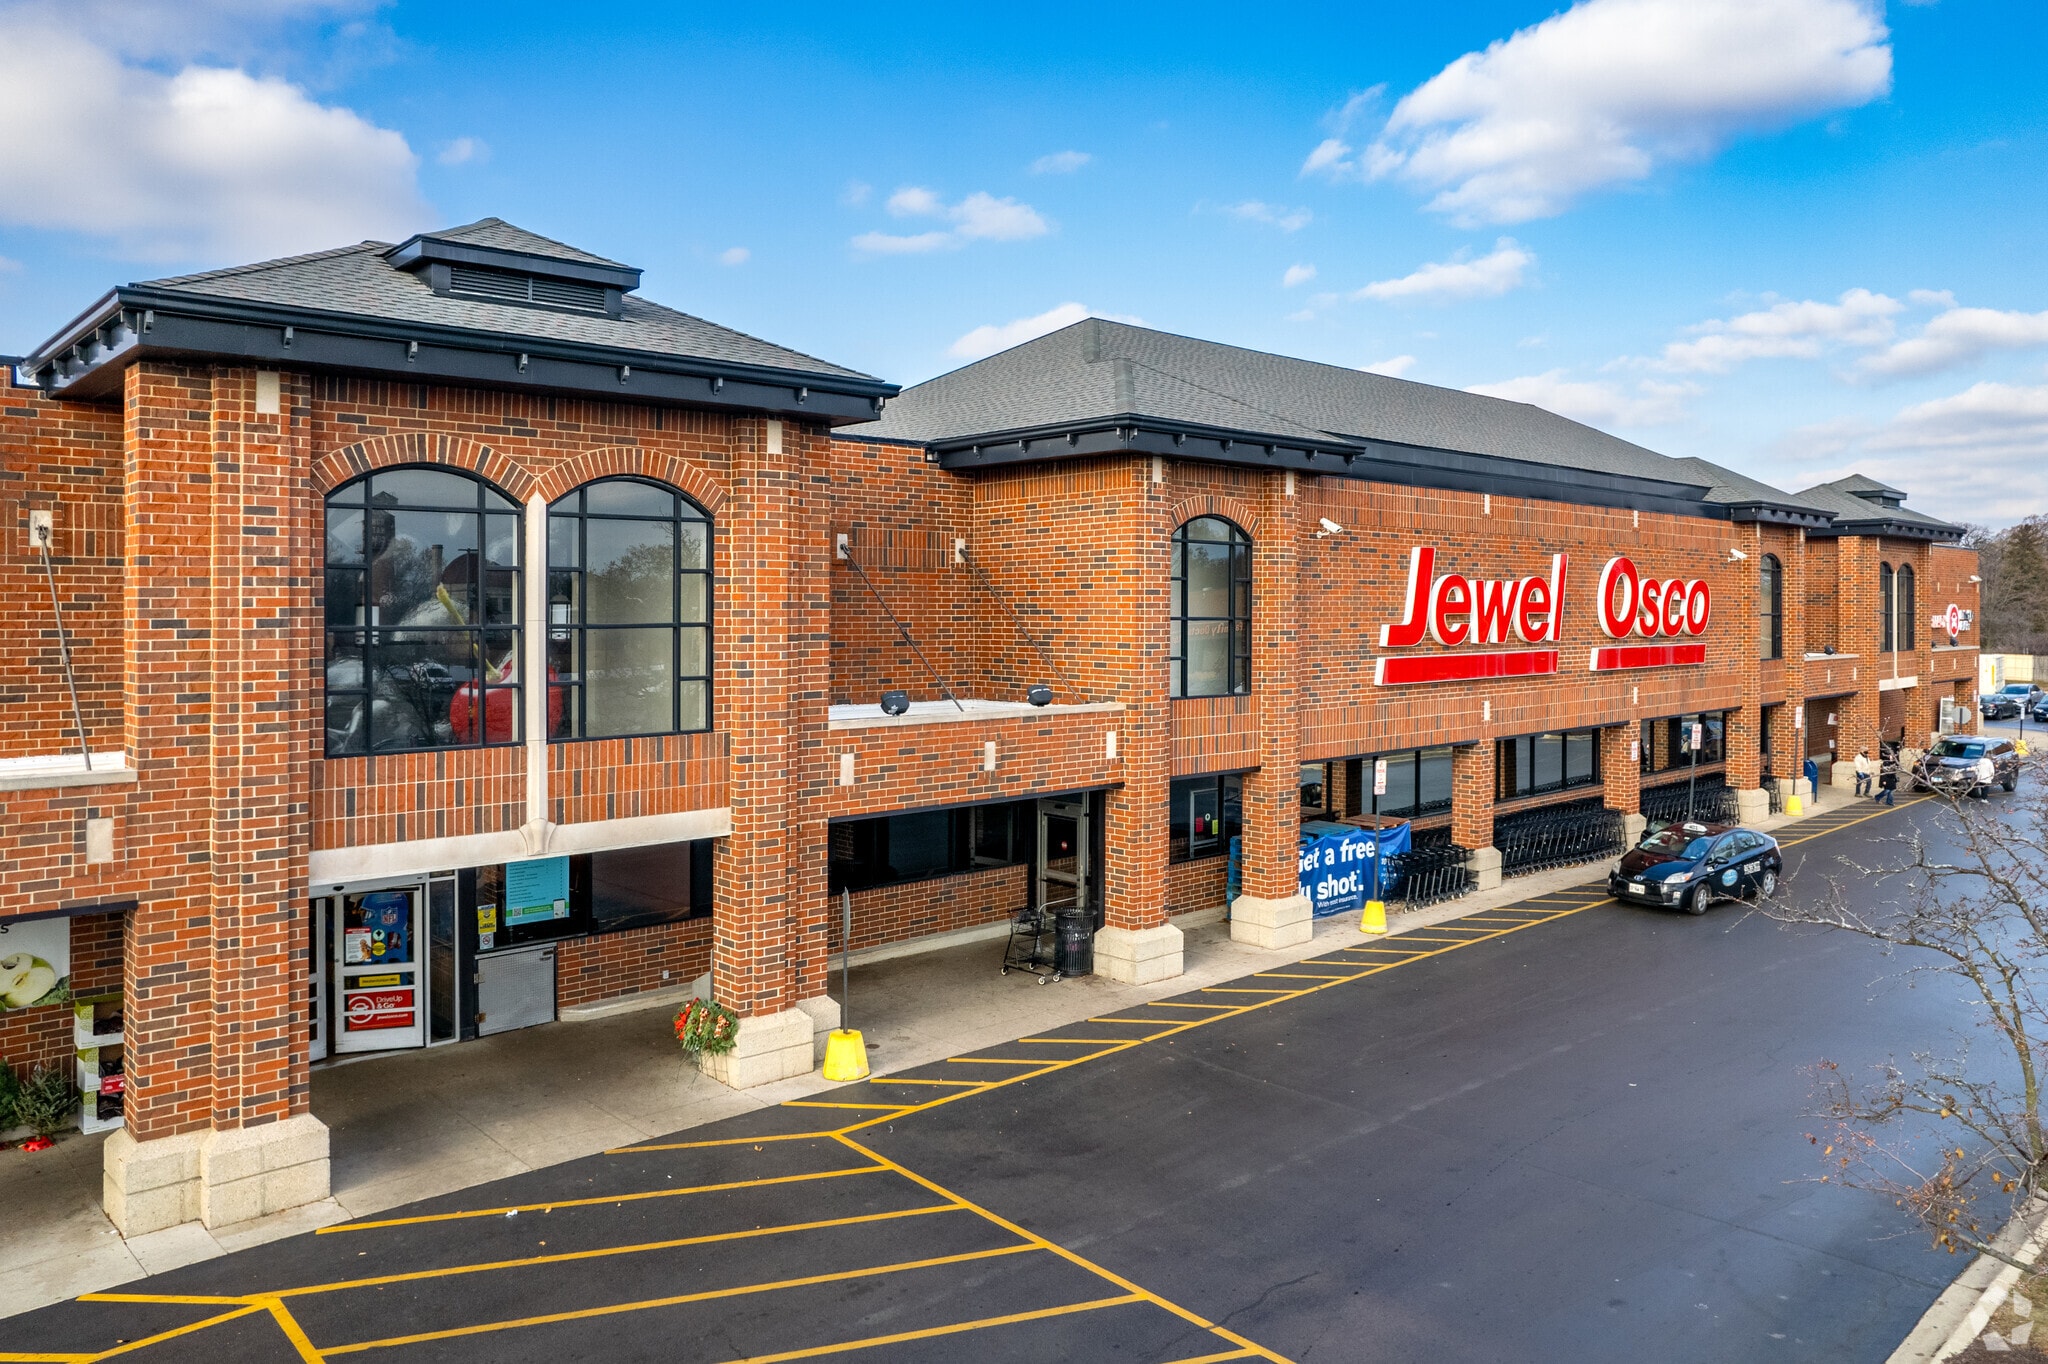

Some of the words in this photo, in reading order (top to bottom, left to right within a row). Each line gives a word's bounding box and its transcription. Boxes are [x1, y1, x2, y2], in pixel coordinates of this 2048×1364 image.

[1379, 547, 1569, 647] Jewel
[1597, 556, 1711, 639] Osco
[1324, 848, 1335, 866] a
[1340, 838, 1376, 863] free
[1317, 900, 1330, 908] With
[382, 914, 398, 924] NFL
[376, 995, 403, 1003] DriveUp
